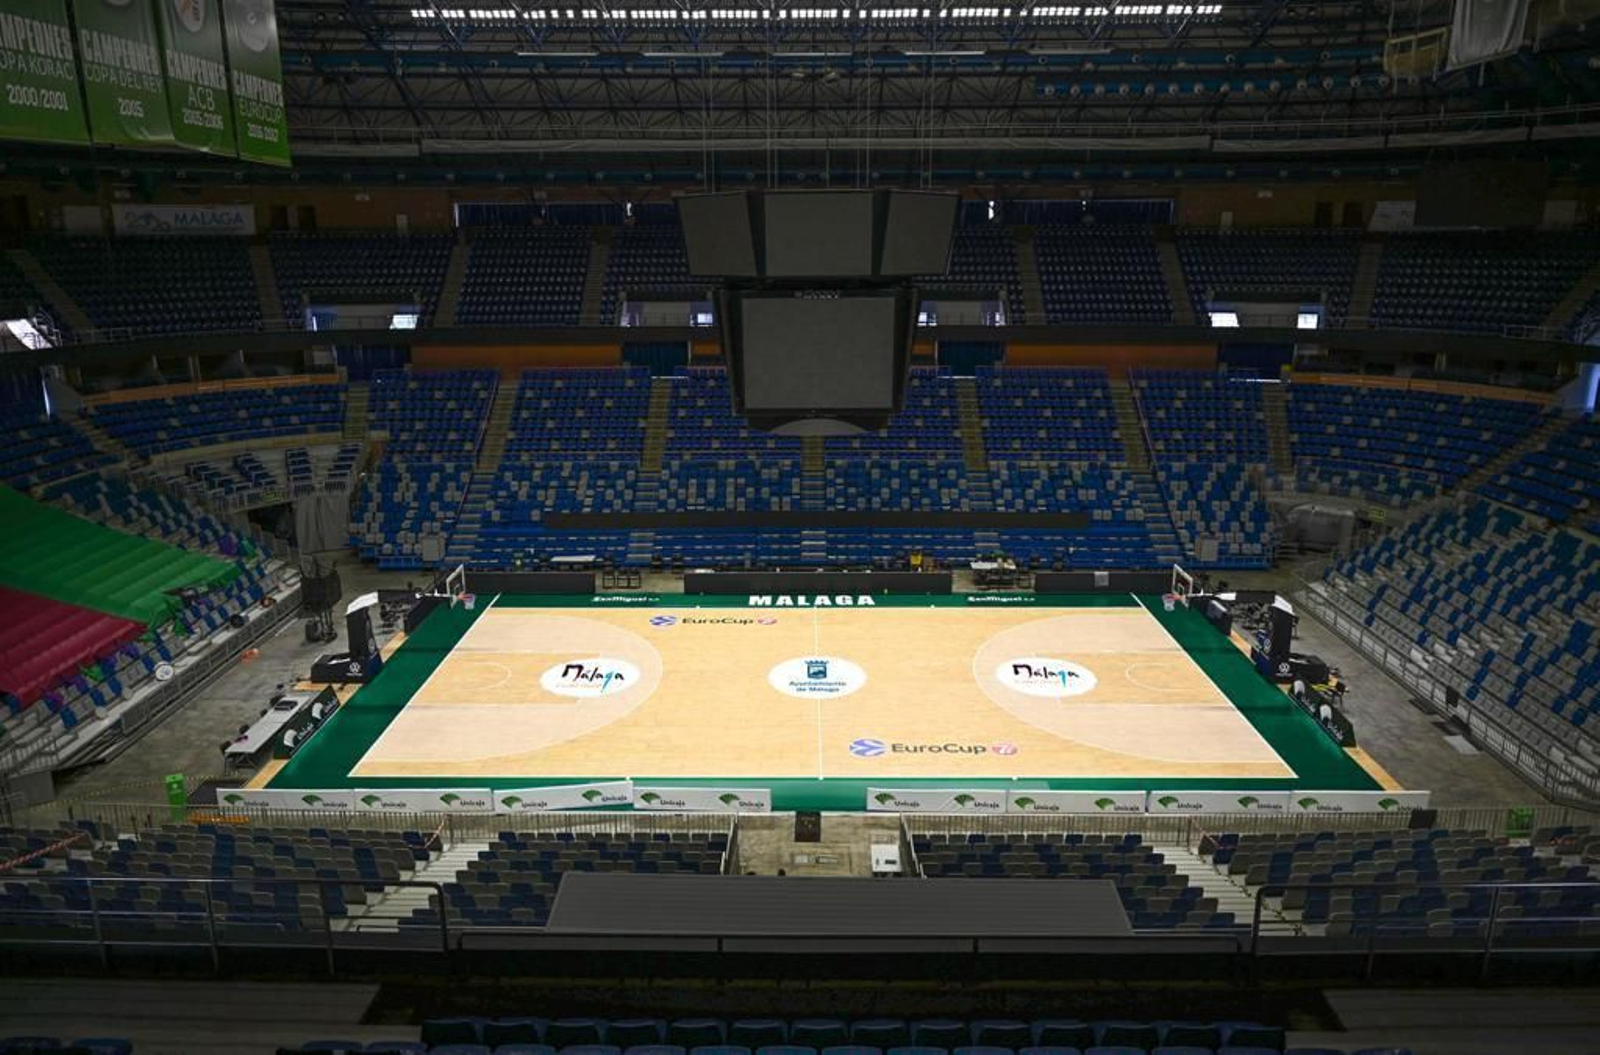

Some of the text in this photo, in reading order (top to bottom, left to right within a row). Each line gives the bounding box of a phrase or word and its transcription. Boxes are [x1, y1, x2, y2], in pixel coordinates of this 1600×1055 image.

[0, 12, 73, 60] MPEONES
[80, 28, 160, 76] CAMPEONES
[0, 50, 74, 81] OPA KORAC
[166, 49, 226, 90] CAMPEONES
[86, 62, 162, 94] COPA DEL REY
[5, 83, 69, 111] 2000/2001
[188, 84, 215, 111] ACB
[117, 97, 144, 118] 2005
[748, 594, 876, 606] MALAGA
[682, 616, 754, 626] EuroCup
[891, 742, 987, 755] EuroCup
[460, 799, 485, 808] Unicaja
[521, 800, 548, 809] Unicaja
[660, 799, 686, 808] Unicaja
[974, 801, 1000, 809] Unicaja
[1177, 802, 1203, 810] Unicaja
